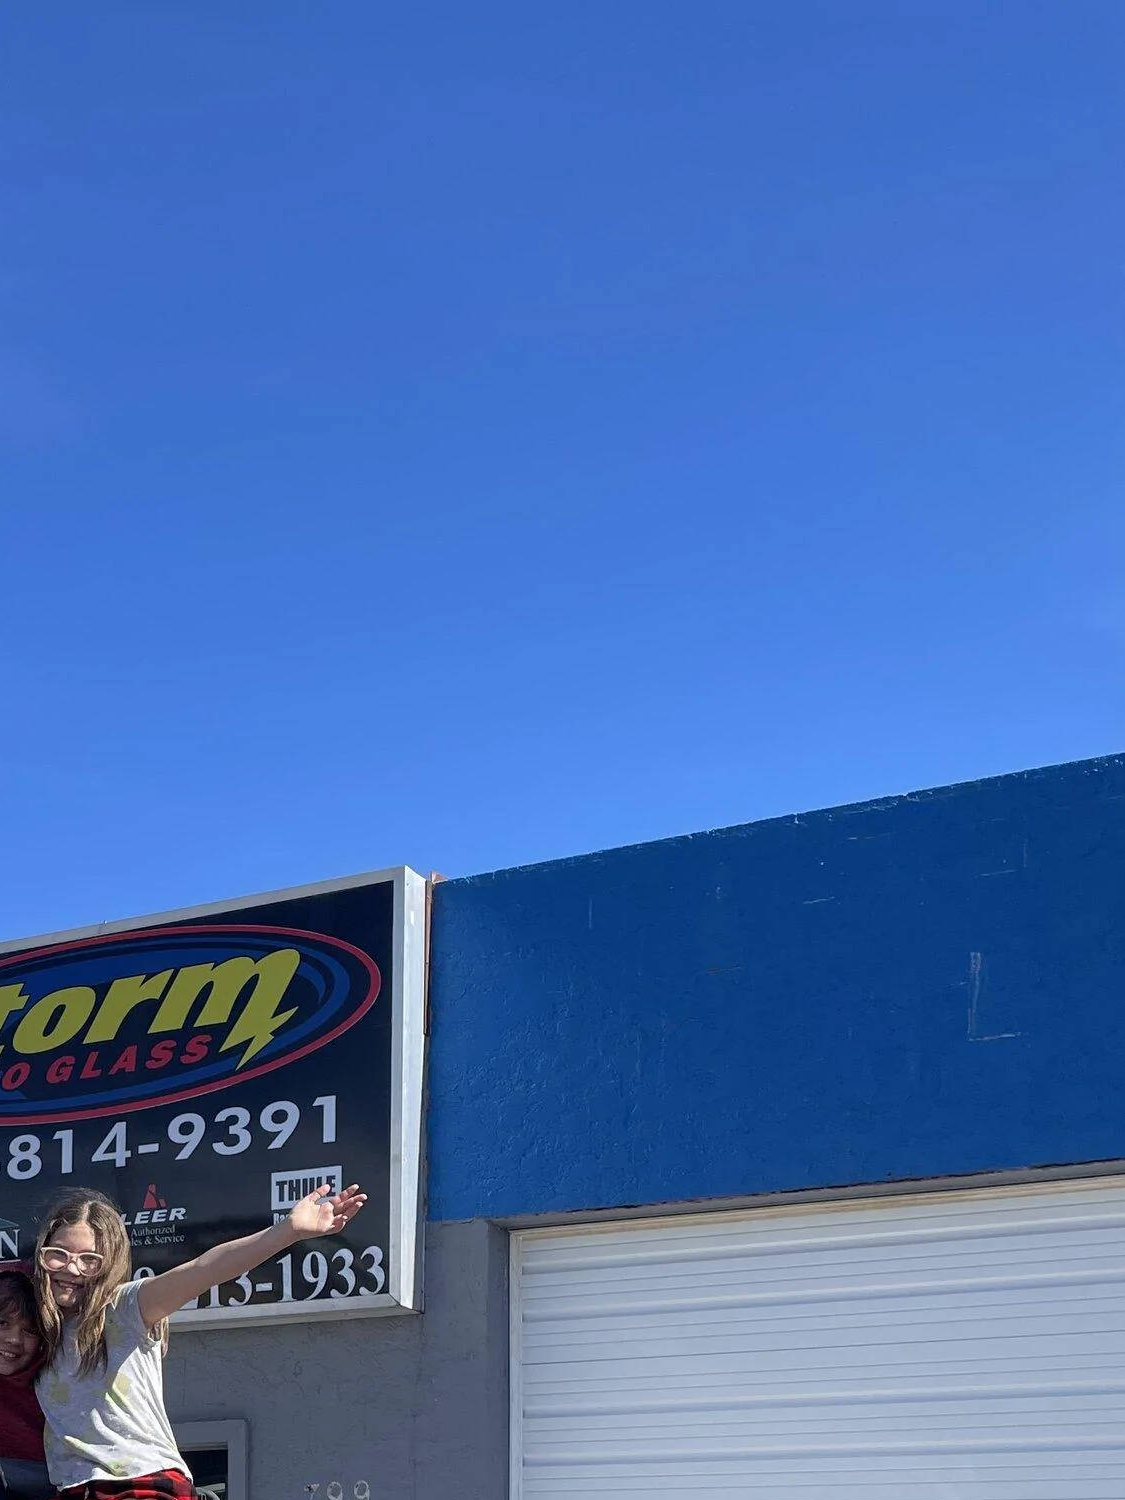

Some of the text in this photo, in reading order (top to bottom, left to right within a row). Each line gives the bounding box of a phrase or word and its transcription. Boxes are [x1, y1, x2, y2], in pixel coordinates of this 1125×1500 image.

[45, 1034, 214, 1085] GLASS
[120, 1207, 186, 1225] LEER
[131, 1224, 175, 1237] Authorized
[154, 1235, 185, 1244] Service
